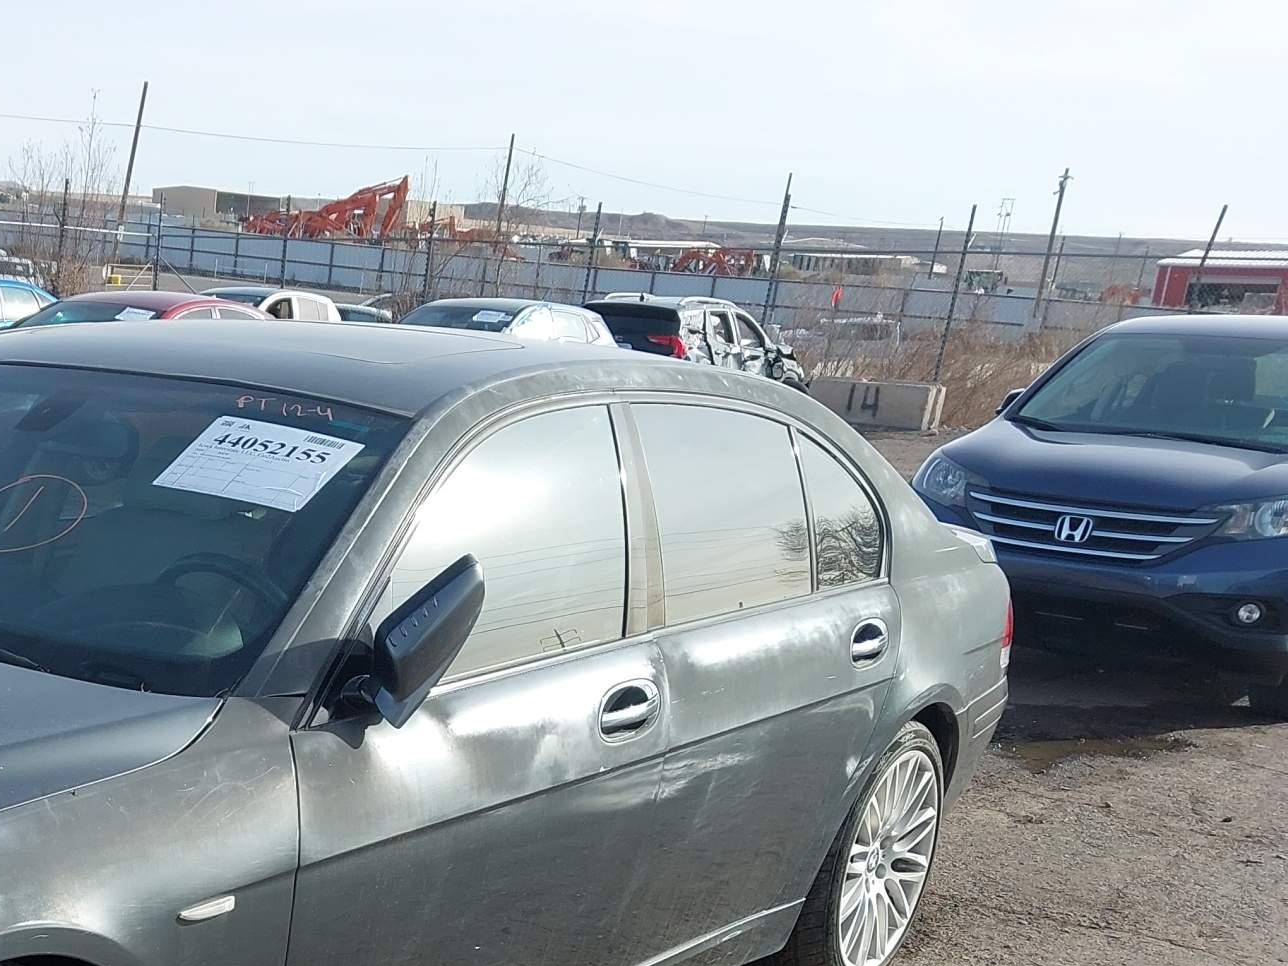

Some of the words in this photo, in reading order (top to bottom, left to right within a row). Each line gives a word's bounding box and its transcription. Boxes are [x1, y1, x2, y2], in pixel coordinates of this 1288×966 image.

[236, 395, 277, 411] PT
[282, 402, 333, 421] 12-4
[846, 383, 880, 418] 14
[213, 433, 331, 464] 44052155
